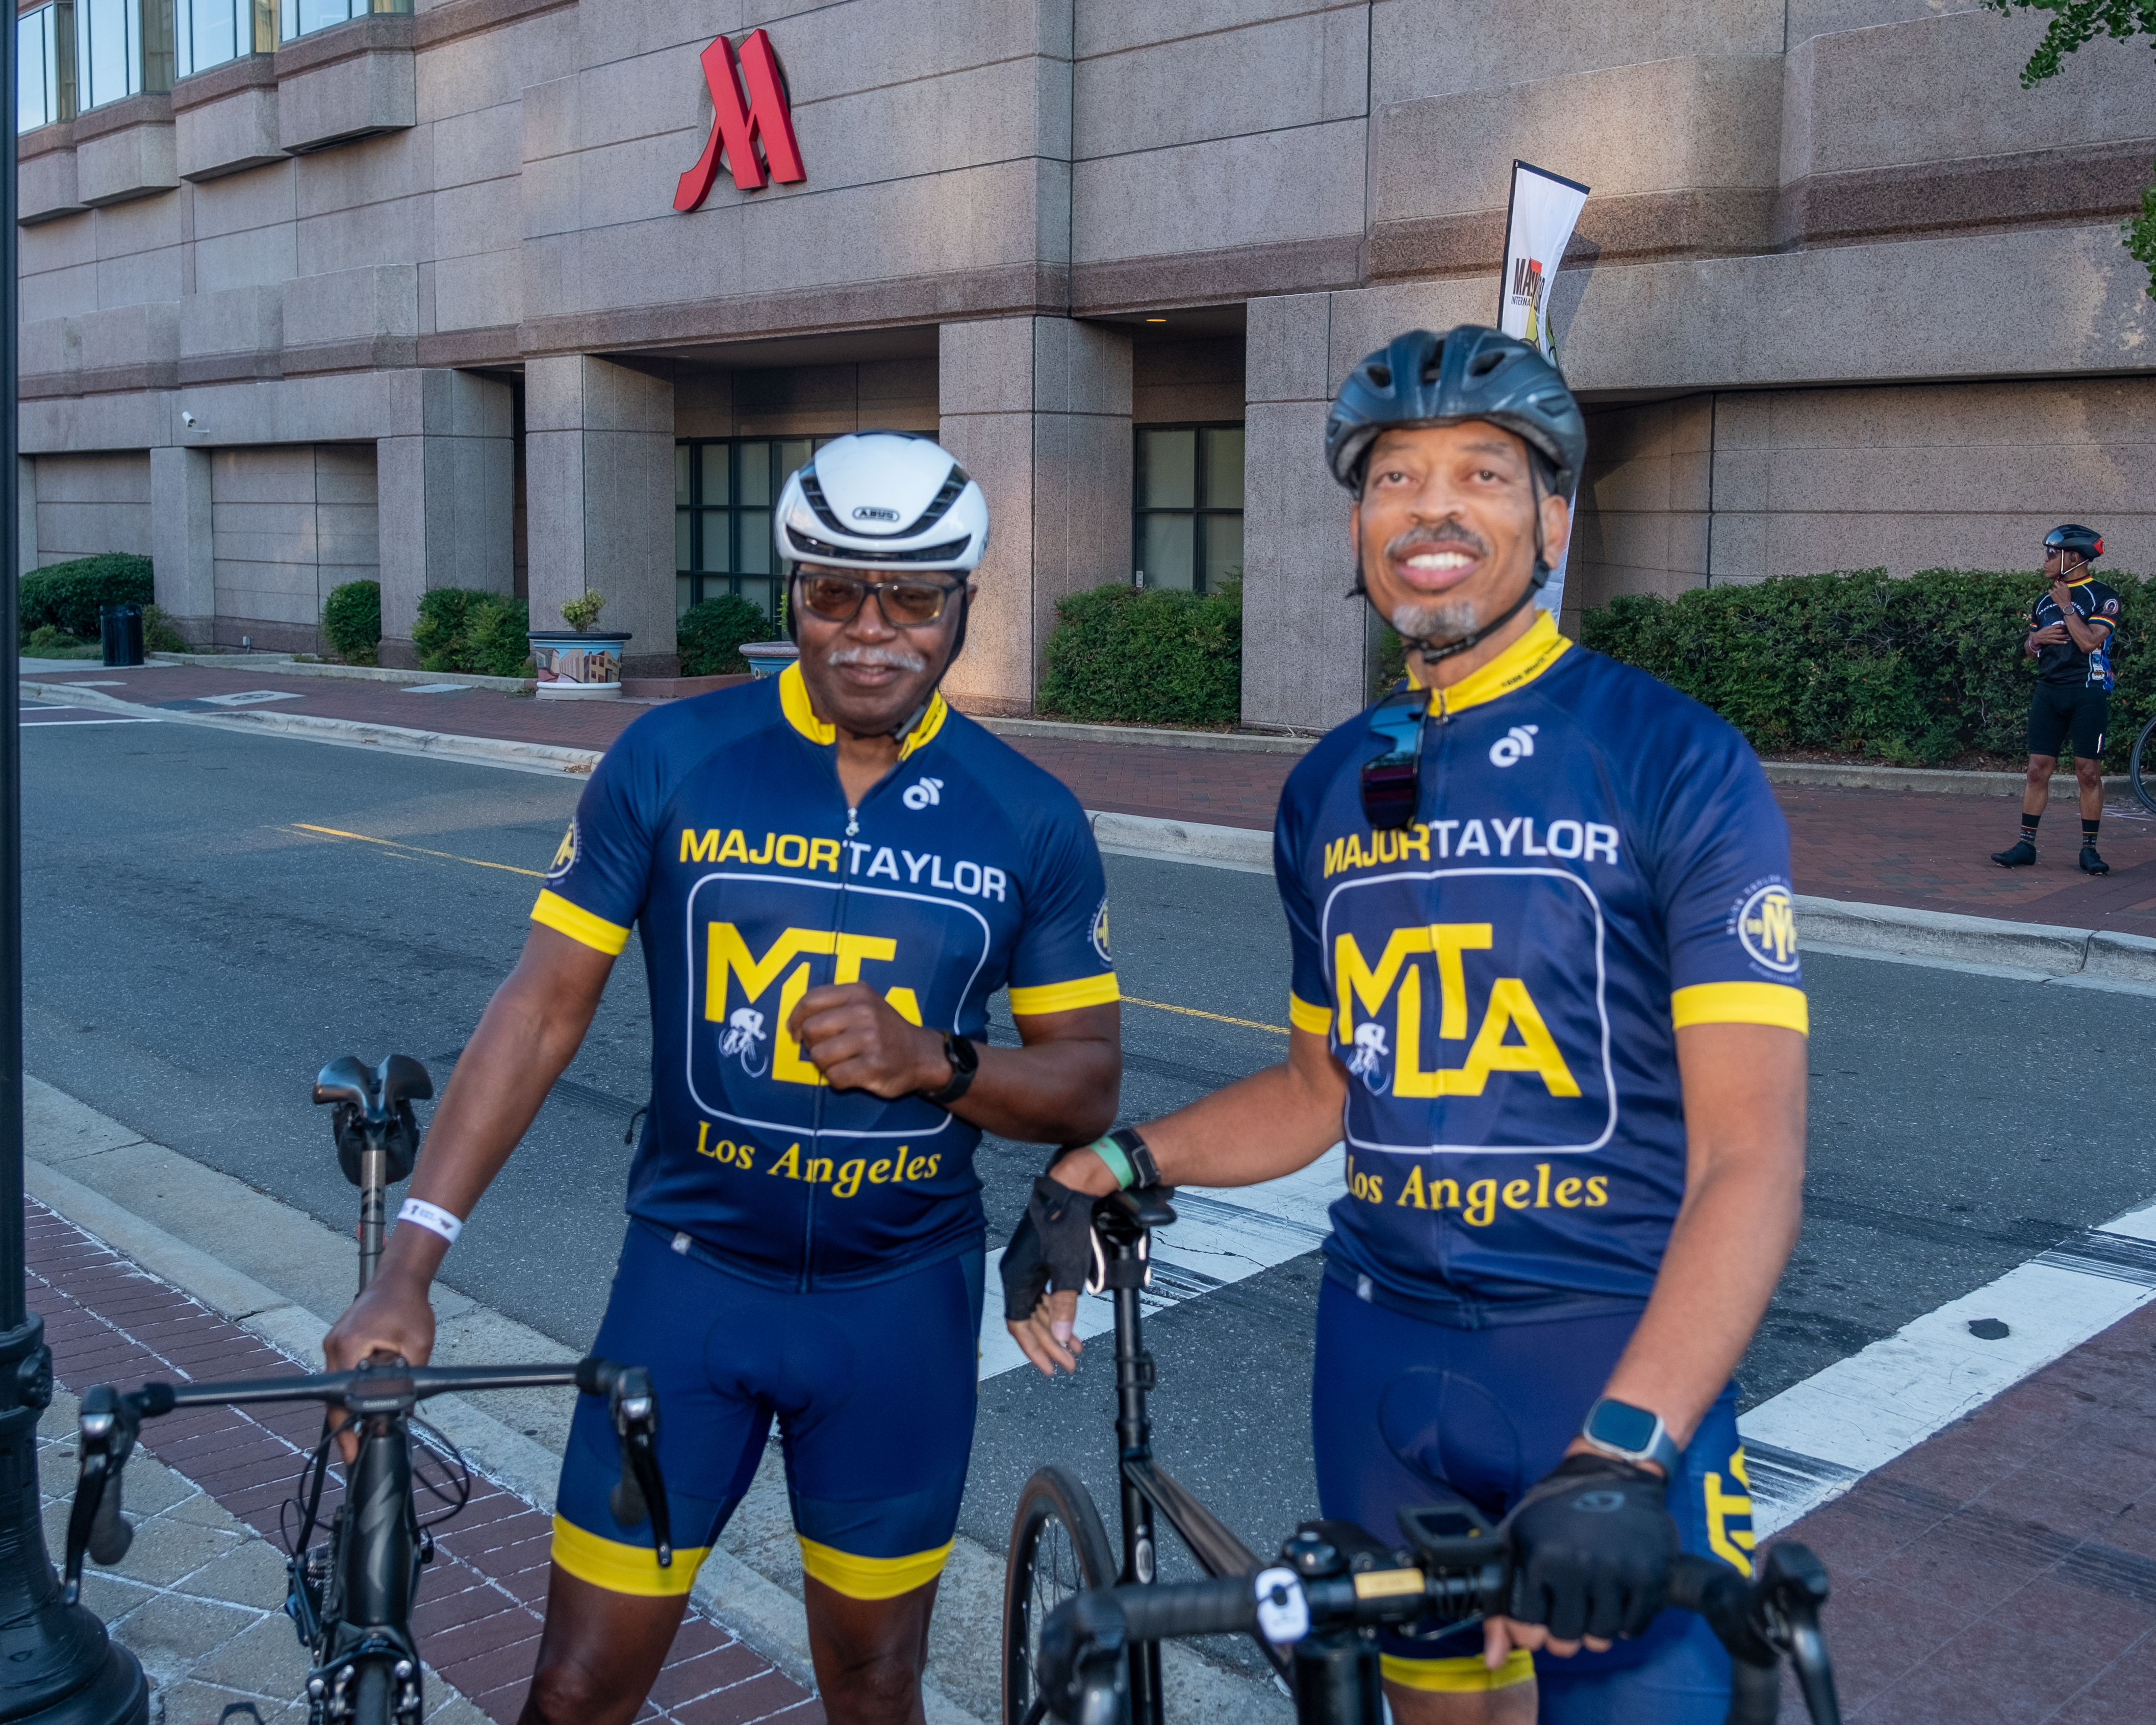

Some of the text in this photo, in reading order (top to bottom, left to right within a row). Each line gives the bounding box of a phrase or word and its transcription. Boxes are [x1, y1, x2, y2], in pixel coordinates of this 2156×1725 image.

[859, 509, 894, 519] ABUS
[696, 1120, 942, 1198] Los Angeles
[1396, 1163, 1609, 1227] Angeles
